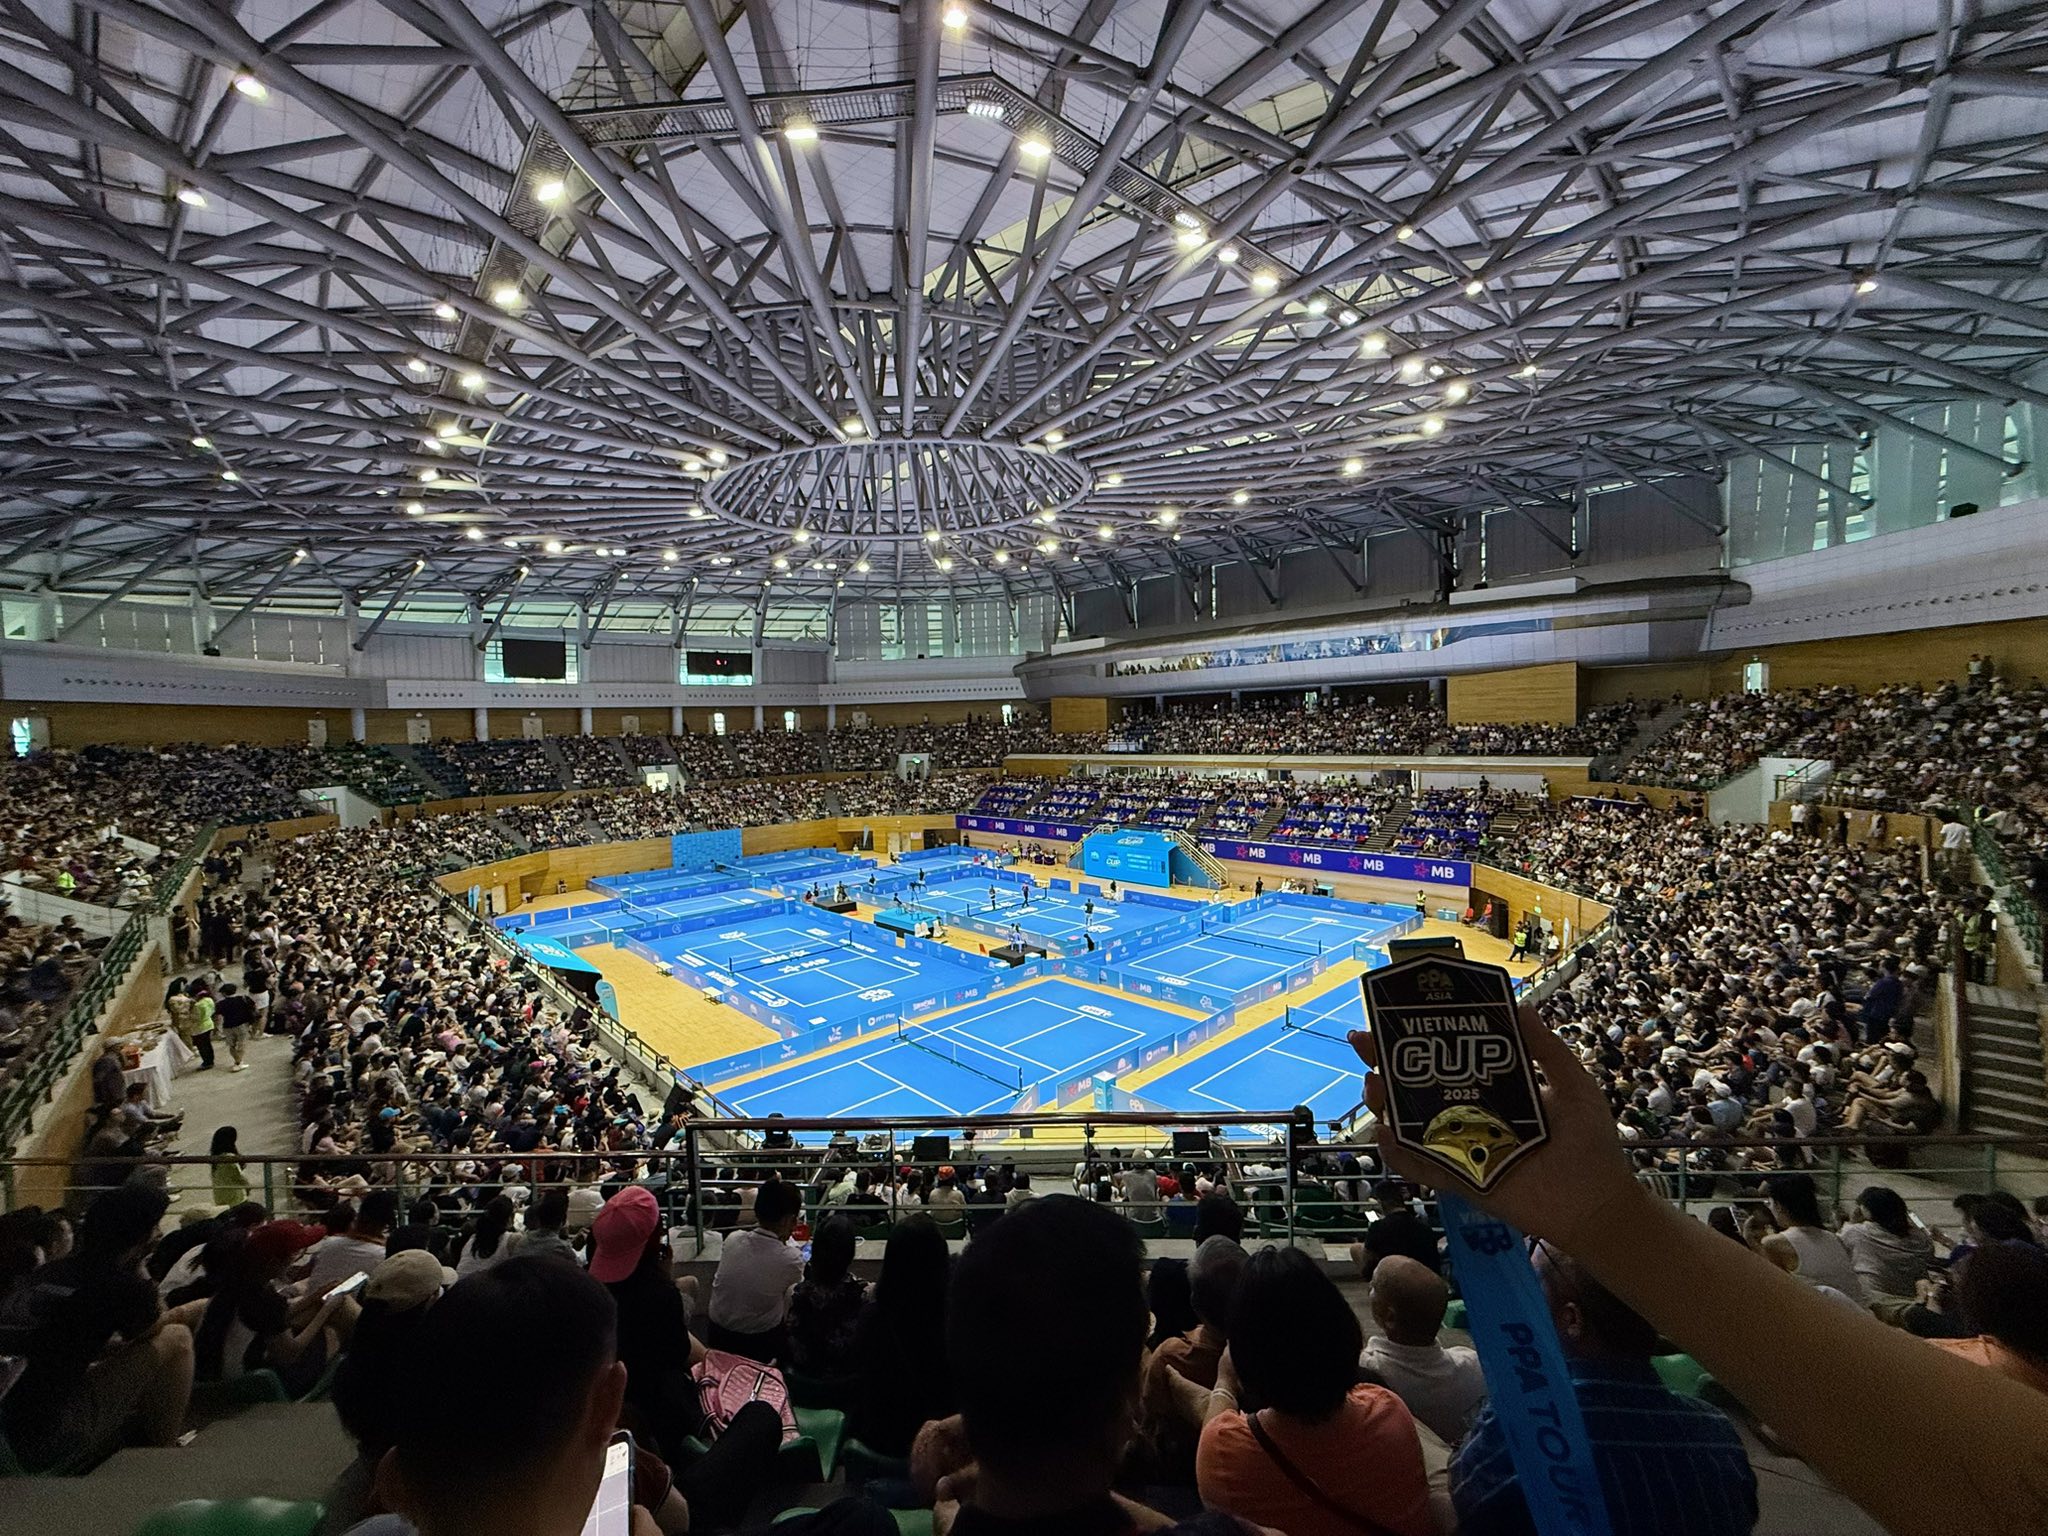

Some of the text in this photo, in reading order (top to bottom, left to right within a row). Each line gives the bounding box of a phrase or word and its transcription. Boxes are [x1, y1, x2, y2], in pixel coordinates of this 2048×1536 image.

[967, 818, 978, 828] MB
[995, 821, 1006, 831] MB
[1024, 824, 1035, 834] MB
[1056, 827, 1068, 837] MB
[1201, 842, 1216, 853] MB
[1249, 847, 1266, 859] MB
[1303, 852, 1322, 865] MB
[1363, 859, 1384, 871] MB
[1431, 865, 1455, 879] MB
[1416, 968, 1454, 990] PPA
[964, 988, 978, 998] MB
[1139, 983, 1152, 993] MB
[1402, 1014, 1489, 1035] VIETNAM
[1392, 1035, 1518, 1089] CUP
[1078, 1077, 1092, 1092] MB
[1443, 1088, 1480, 1100] 2025
[1500, 1322, 1550, 1394] PPA
